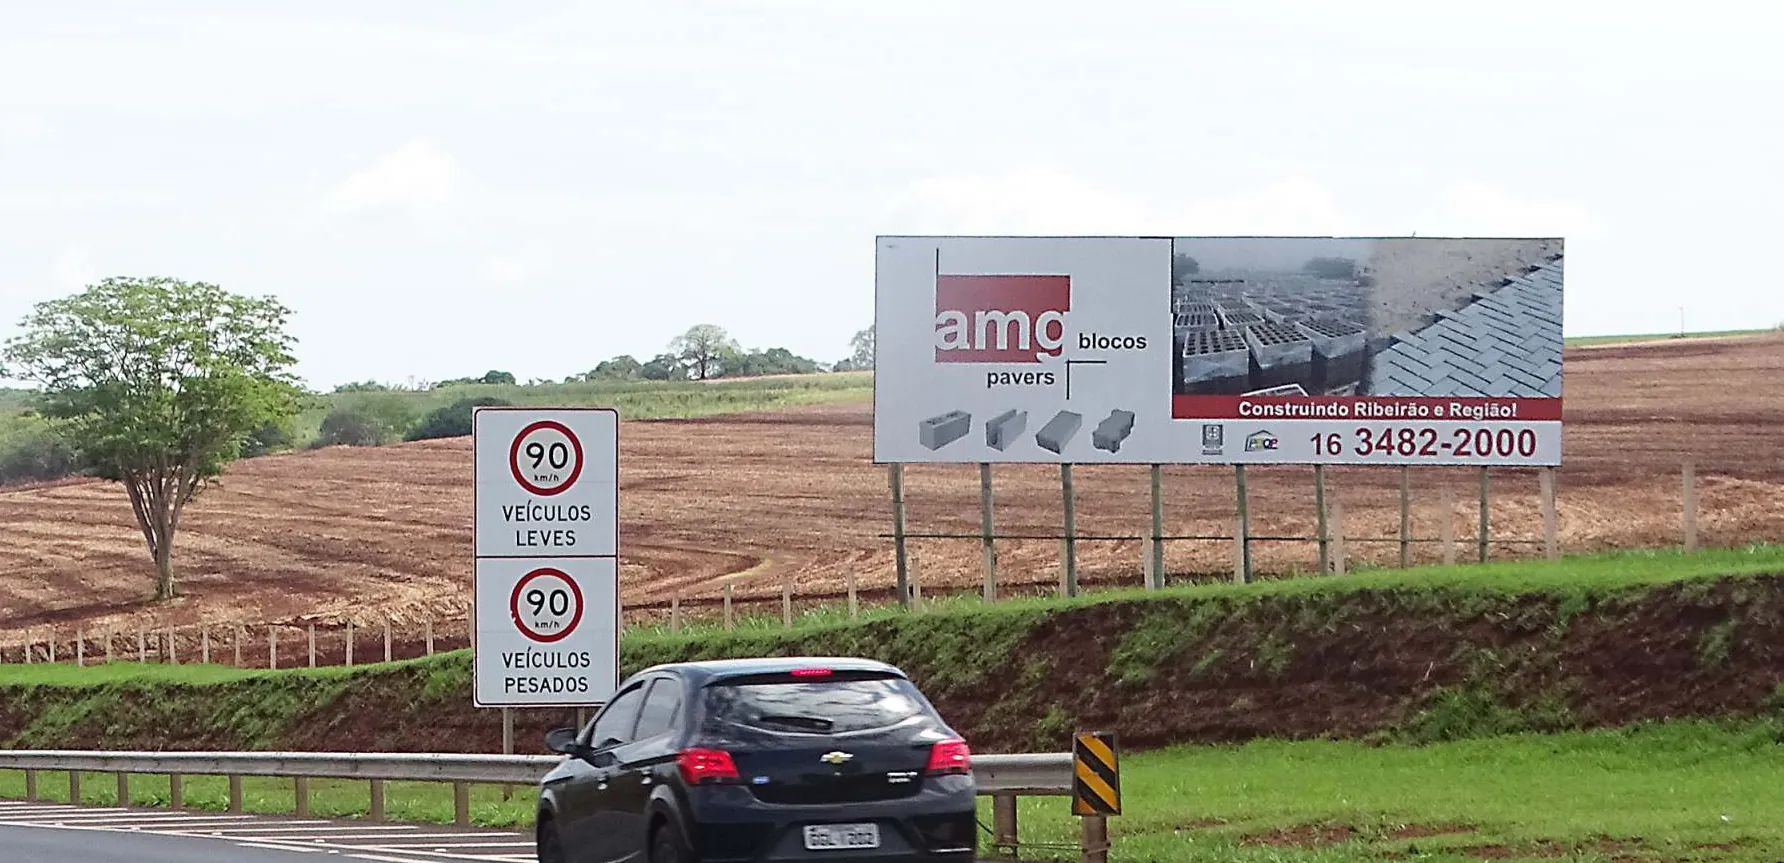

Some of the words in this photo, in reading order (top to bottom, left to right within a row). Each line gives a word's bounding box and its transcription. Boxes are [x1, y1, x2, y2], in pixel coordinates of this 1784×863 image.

[935, 310, 1071, 363] amg
[1078, 333, 1147, 349] blocos
[987, 370, 1055, 388] pavers
[1239, 402, 1349, 417] Construindo
[1354, 402, 1429, 417] Ribeirão
[1433, 406, 1444, 417] e
[1449, 403, 1517, 420] Região!
[1310, 433, 1342, 455] 16
[1354, 428, 1536, 457] 3482-2000
[526, 442, 569, 469] 90
[534, 474, 559, 482] km/h
[502, 500, 591, 522] VEÍCULOS
[516, 530, 576, 546] LEVES
[526, 589, 569, 616] 90
[534, 620, 560, 629] km/h
[502, 647, 591, 668] VEÍCULOS
[505, 677, 588, 693] PESADOS
